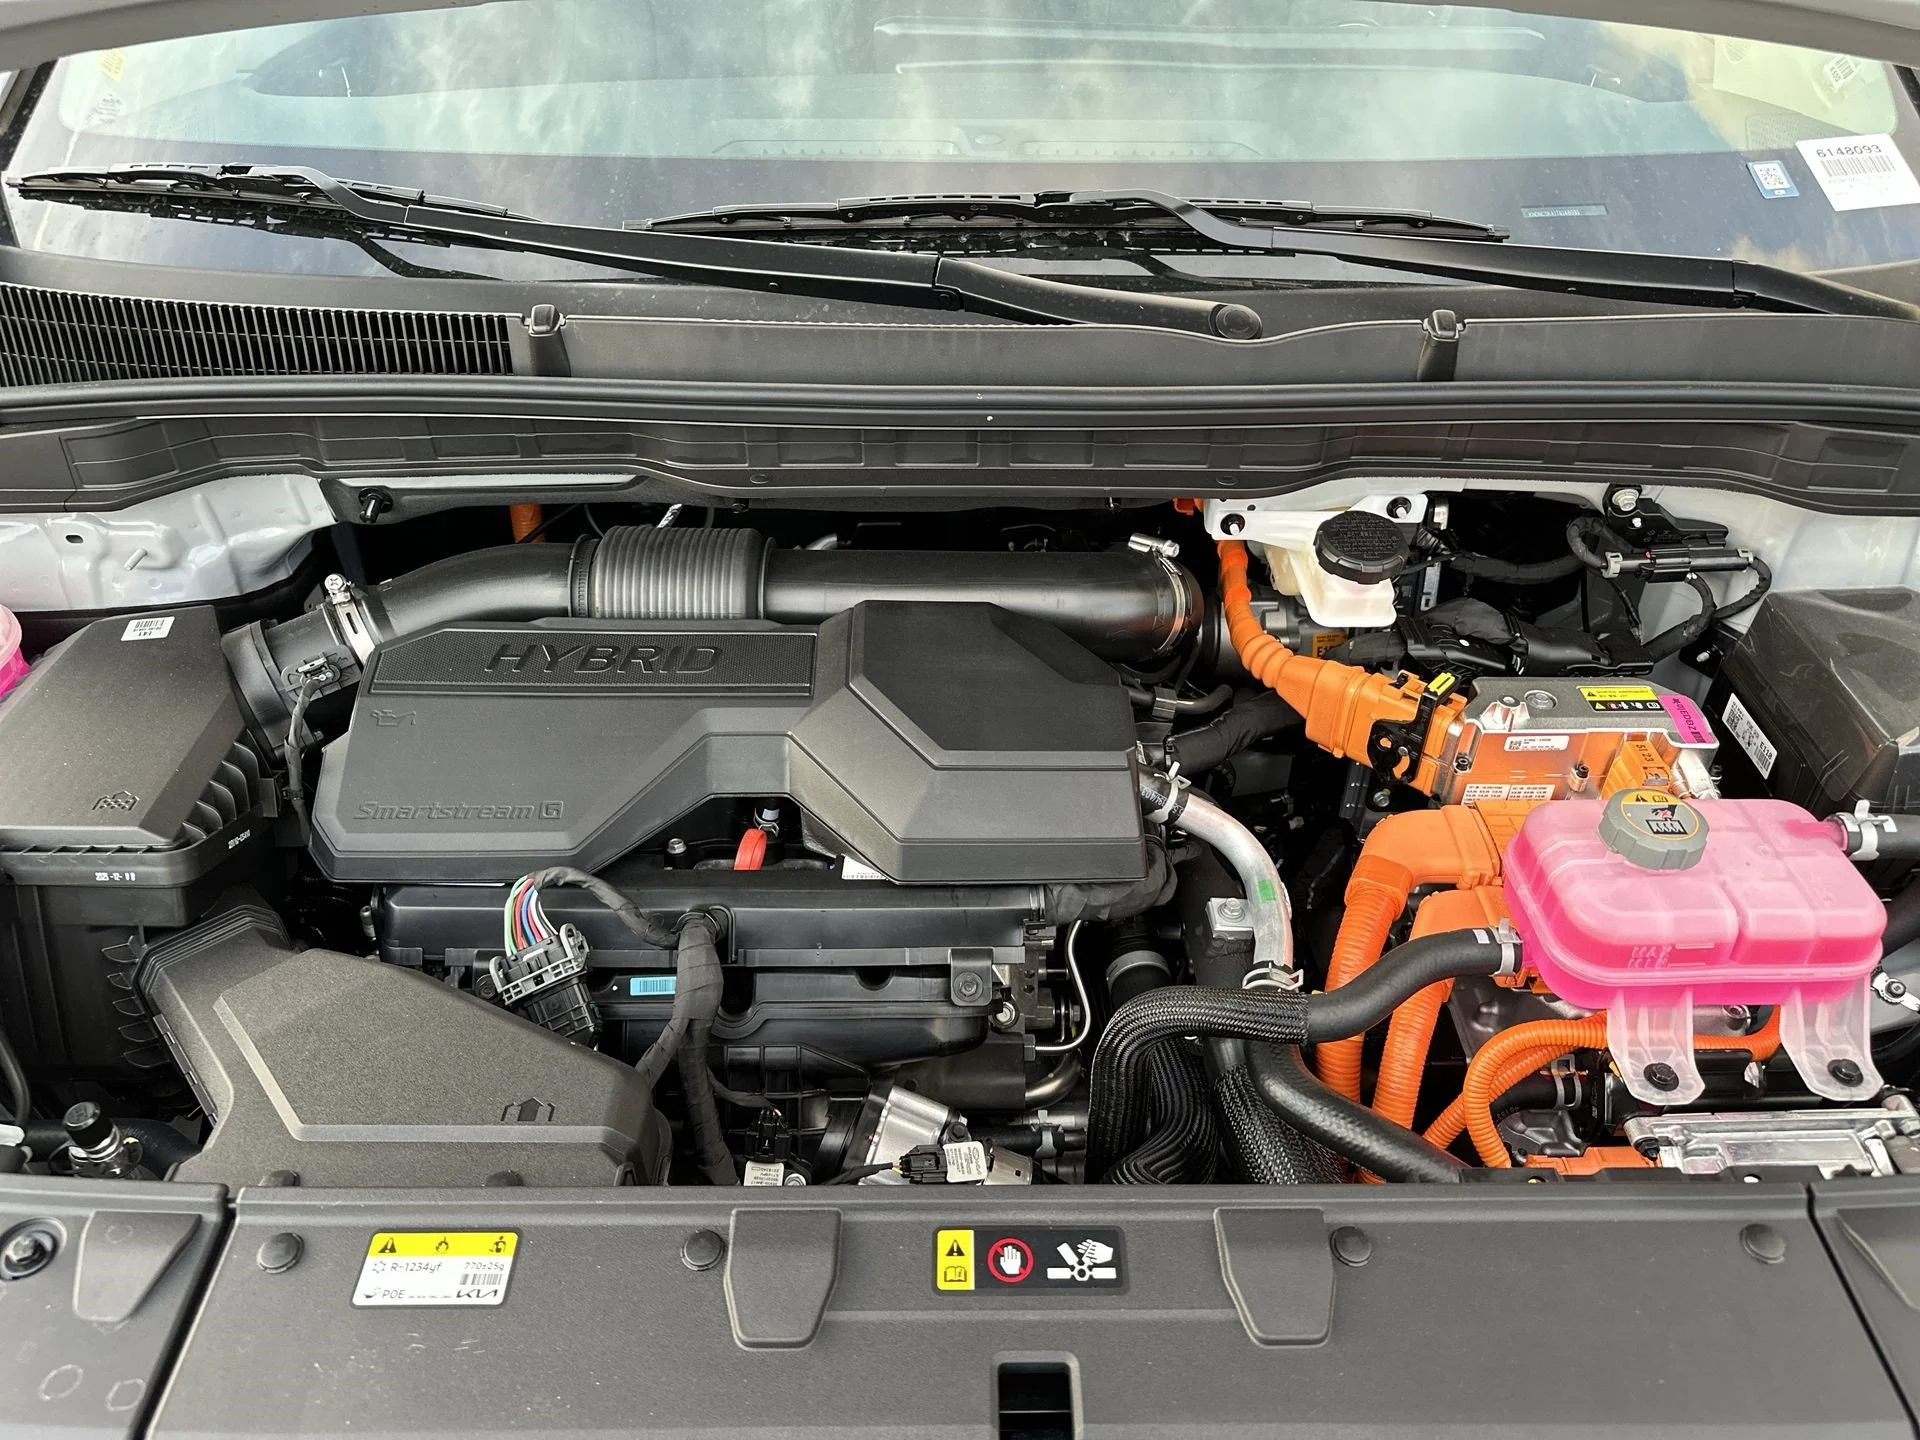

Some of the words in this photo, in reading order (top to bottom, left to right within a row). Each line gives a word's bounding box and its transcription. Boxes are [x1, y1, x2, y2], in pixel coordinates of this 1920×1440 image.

[1816, 144, 1882, 157] 6148093
[484, 644, 723, 673] HYBRID
[353, 801, 534, 820] Smartstream
[390, 1262, 442, 1273] R-1234yf
[382, 1290, 406, 1299] POE
